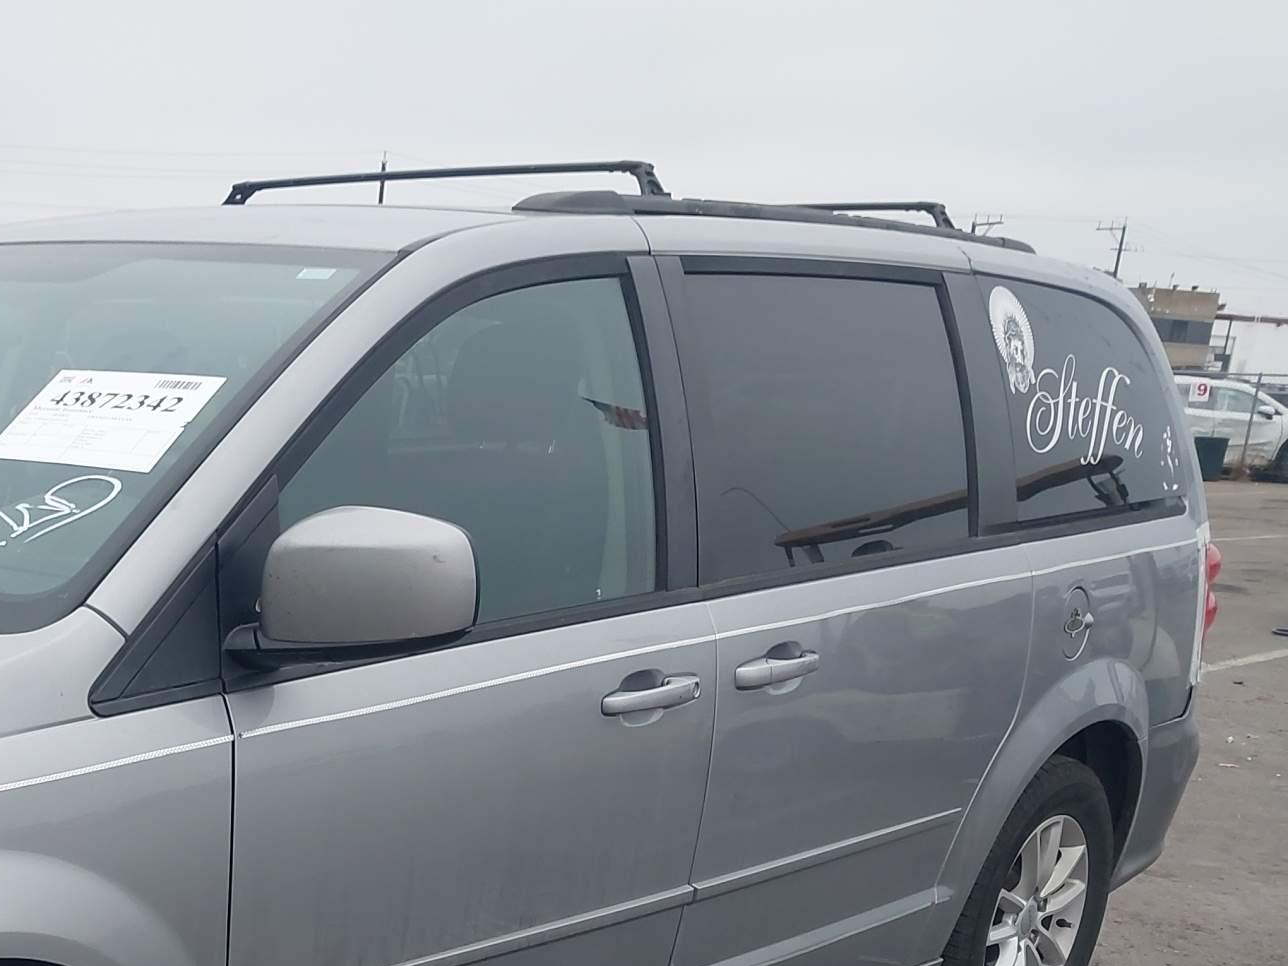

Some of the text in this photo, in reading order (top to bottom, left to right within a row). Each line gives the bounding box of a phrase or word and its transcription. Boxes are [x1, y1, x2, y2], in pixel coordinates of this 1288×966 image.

[50, 390, 184, 412] 43872342
[1197, 384, 1208, 397] 9
[1026, 353, 1144, 465] Steffen
